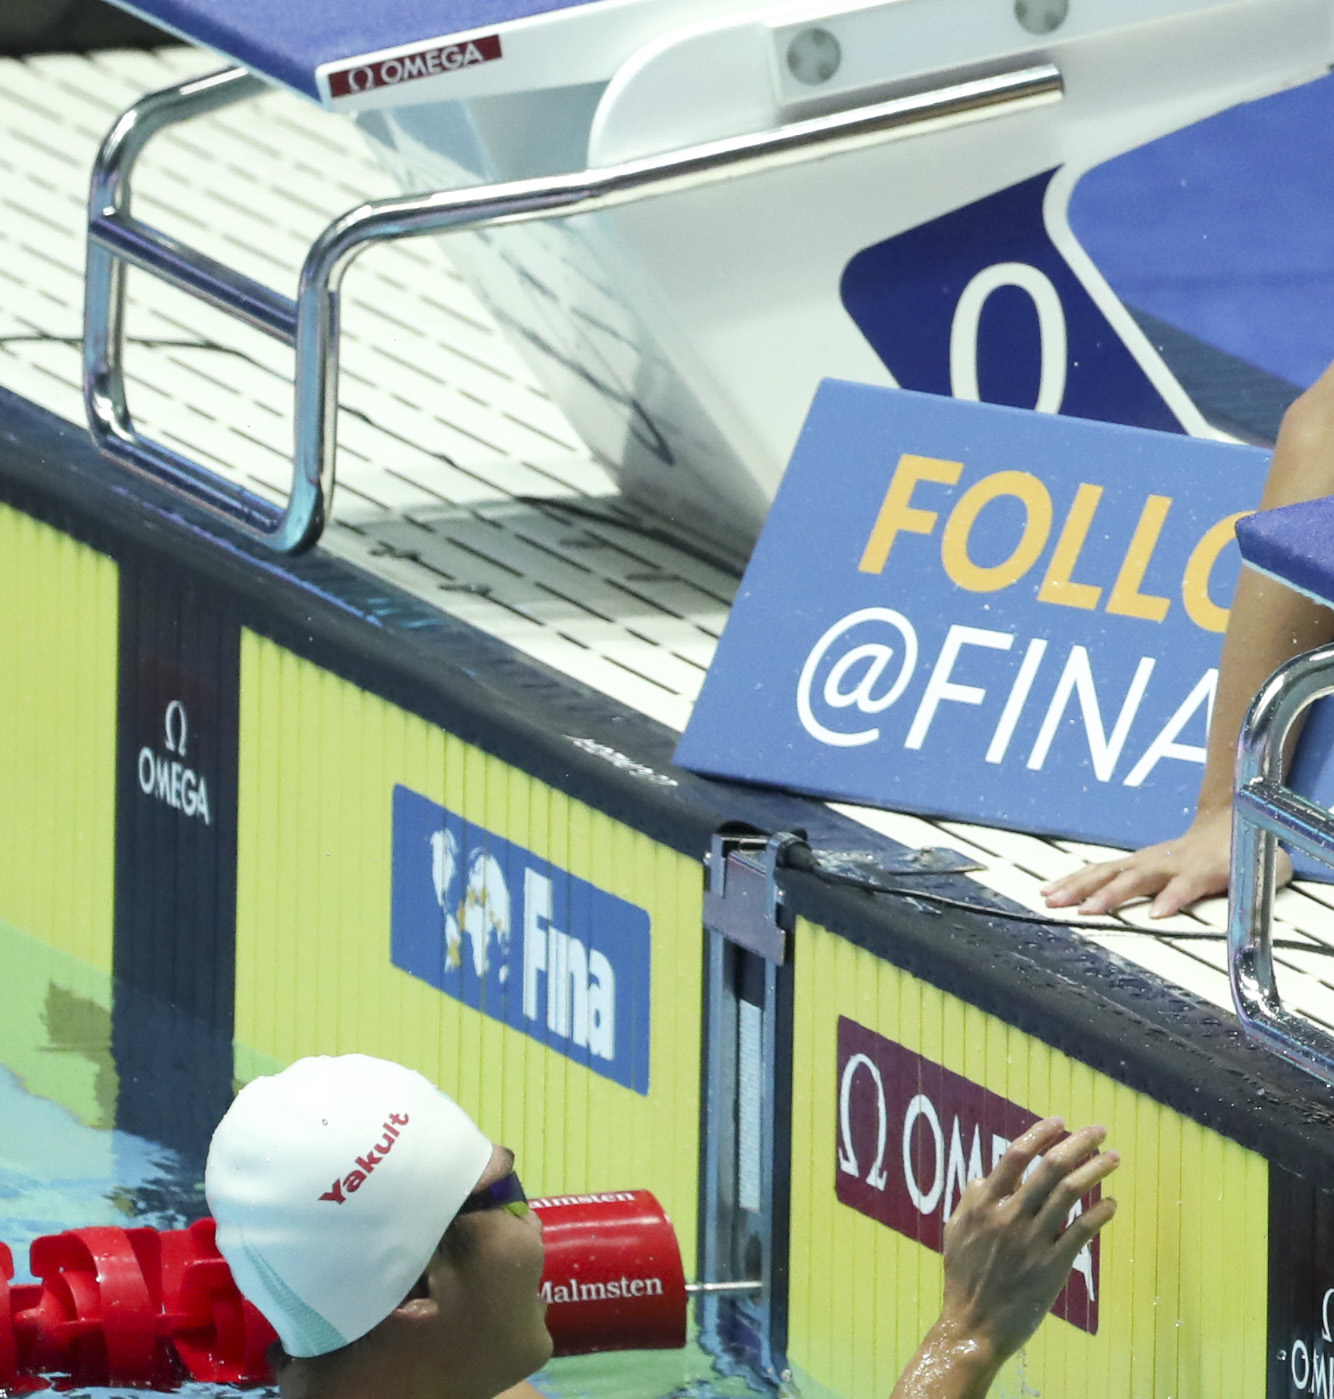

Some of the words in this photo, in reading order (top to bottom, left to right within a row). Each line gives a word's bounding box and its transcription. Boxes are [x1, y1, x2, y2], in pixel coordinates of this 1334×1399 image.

[380, 40, 484, 86] OMEGA
[950, 261, 1068, 416] 0
[857, 452, 1258, 635] FOLLO
[138, 745, 212, 826] OMEGA
[317, 1112, 410, 1206] Yakult
[528, 1191, 636, 1210] almsten
